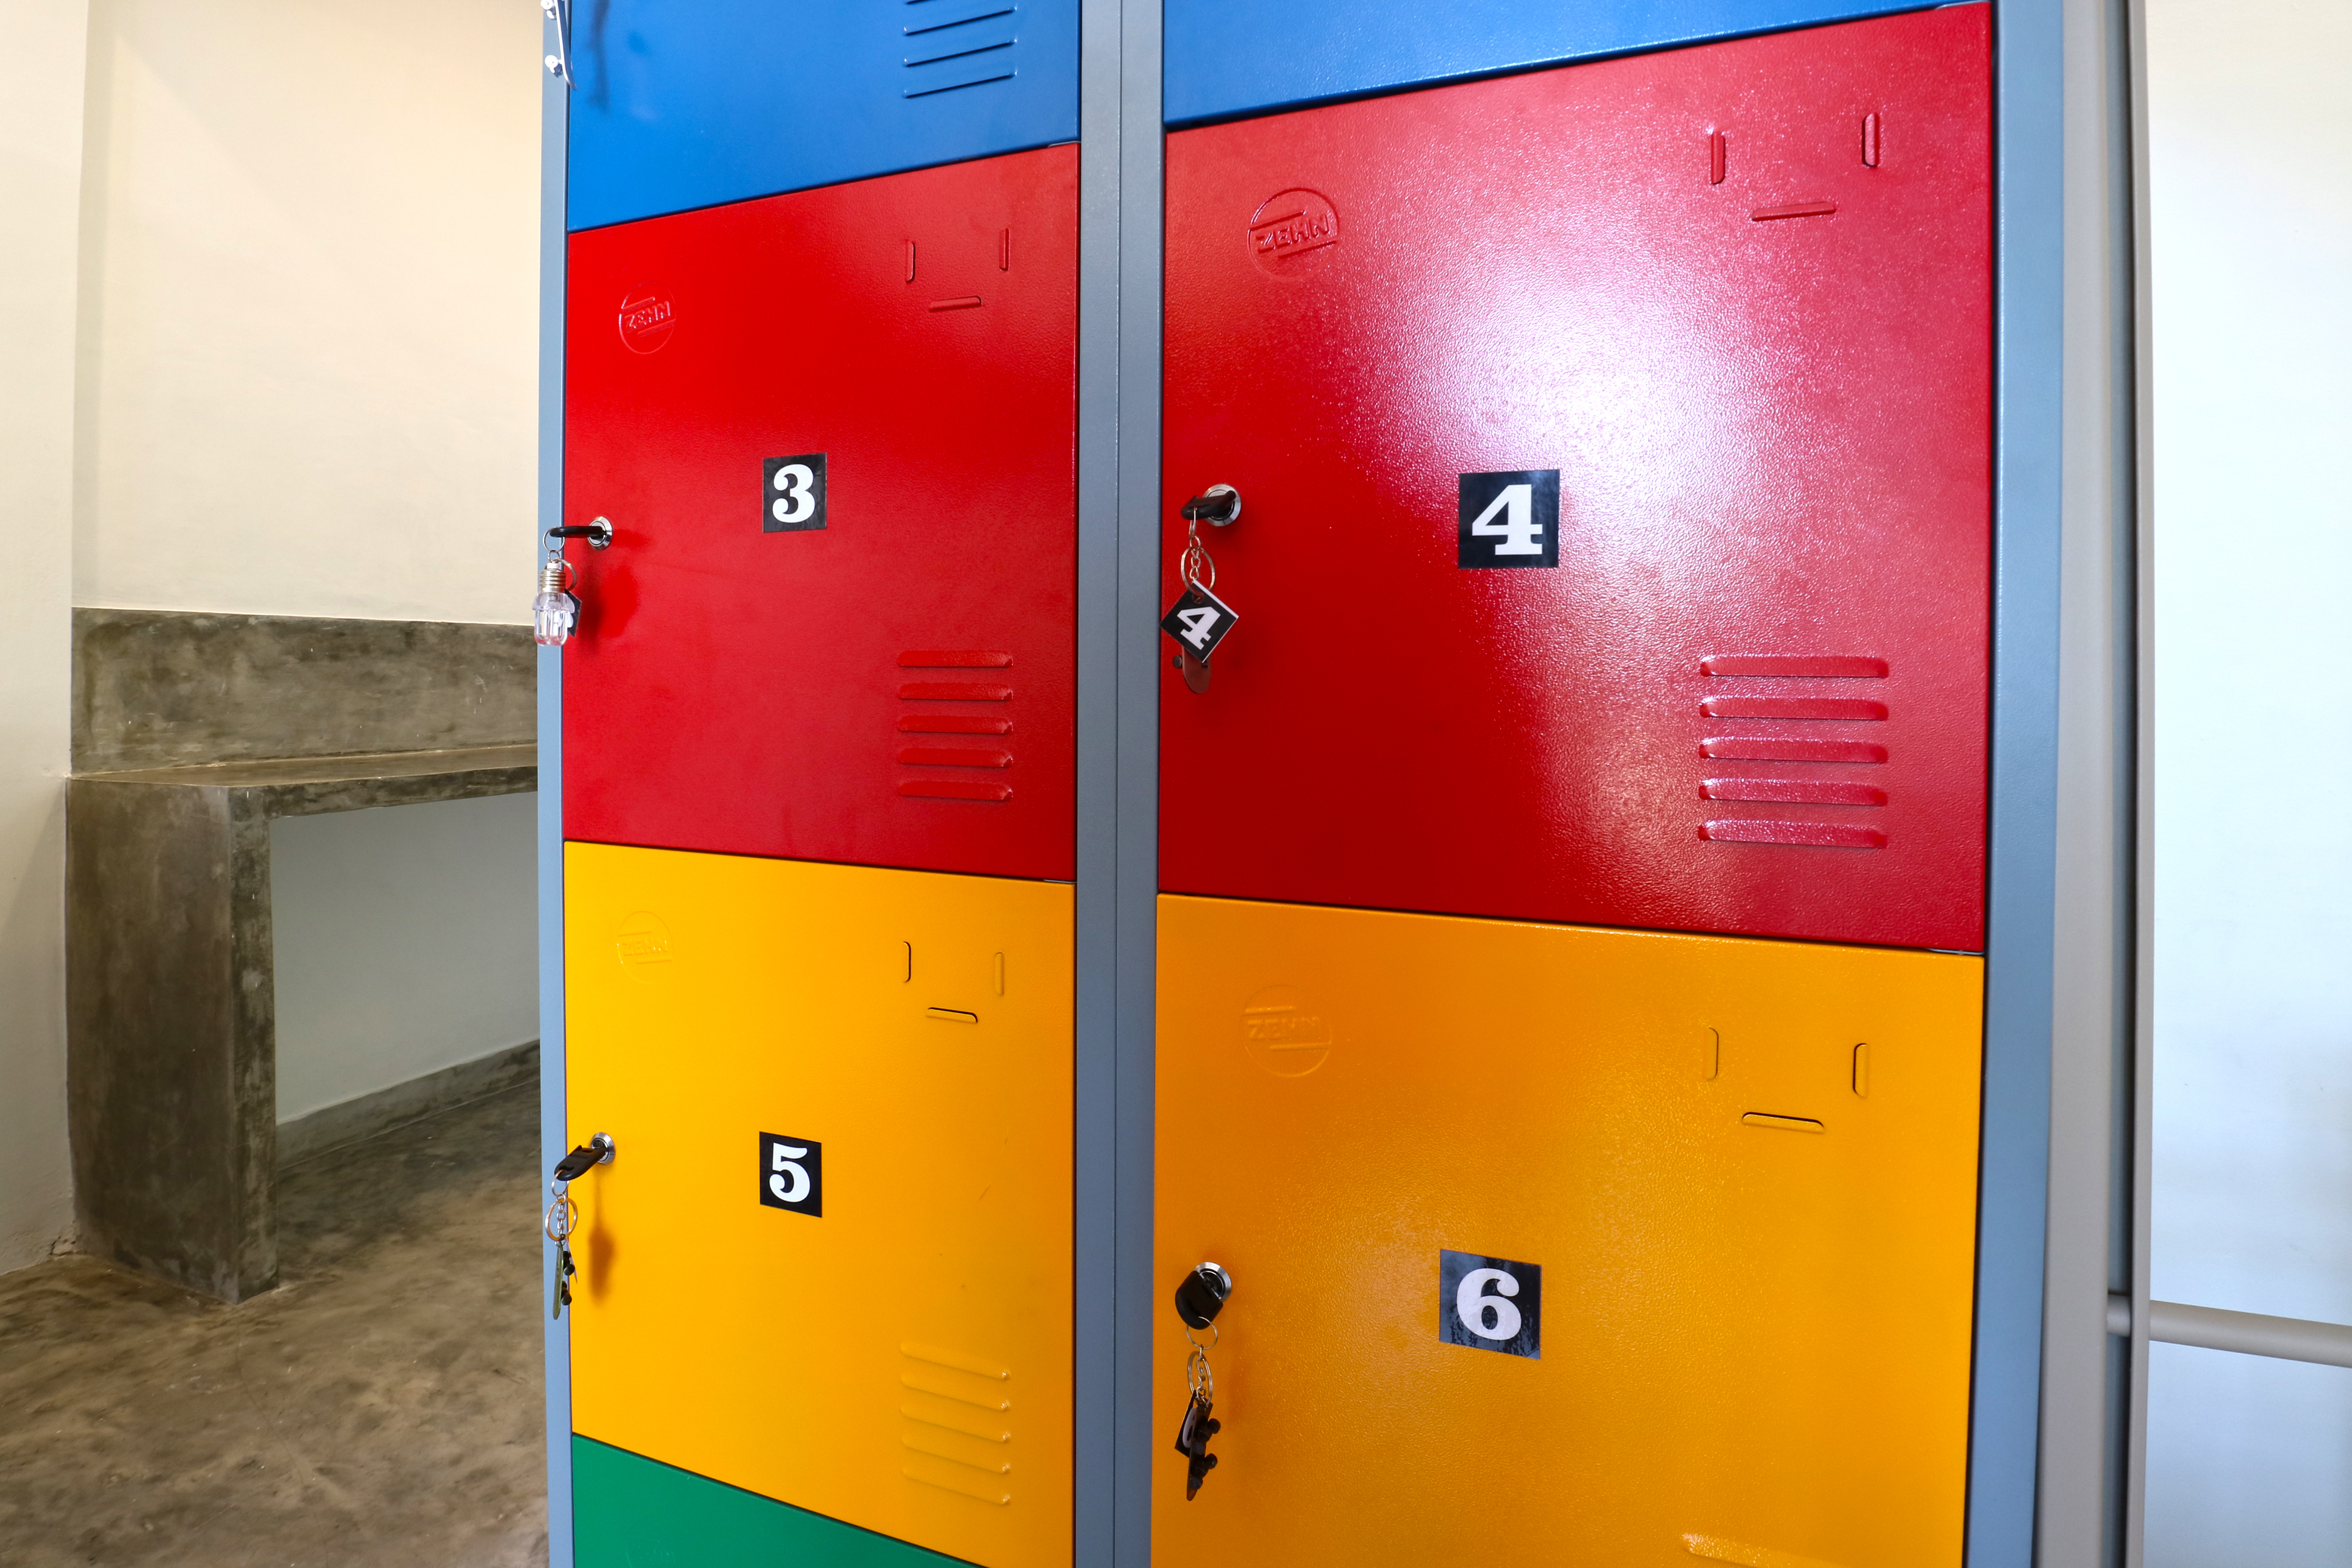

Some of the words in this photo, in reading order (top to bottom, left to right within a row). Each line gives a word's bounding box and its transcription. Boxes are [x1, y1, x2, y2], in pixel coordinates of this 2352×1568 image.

[1255, 214, 1331, 253] ZEHN
[773, 464, 815, 523] 3
[1472, 484, 1543, 555] 4
[1177, 606, 1221, 651] 4
[769, 1142, 810, 1203] 5
[1456, 1268, 1522, 1341] 6
